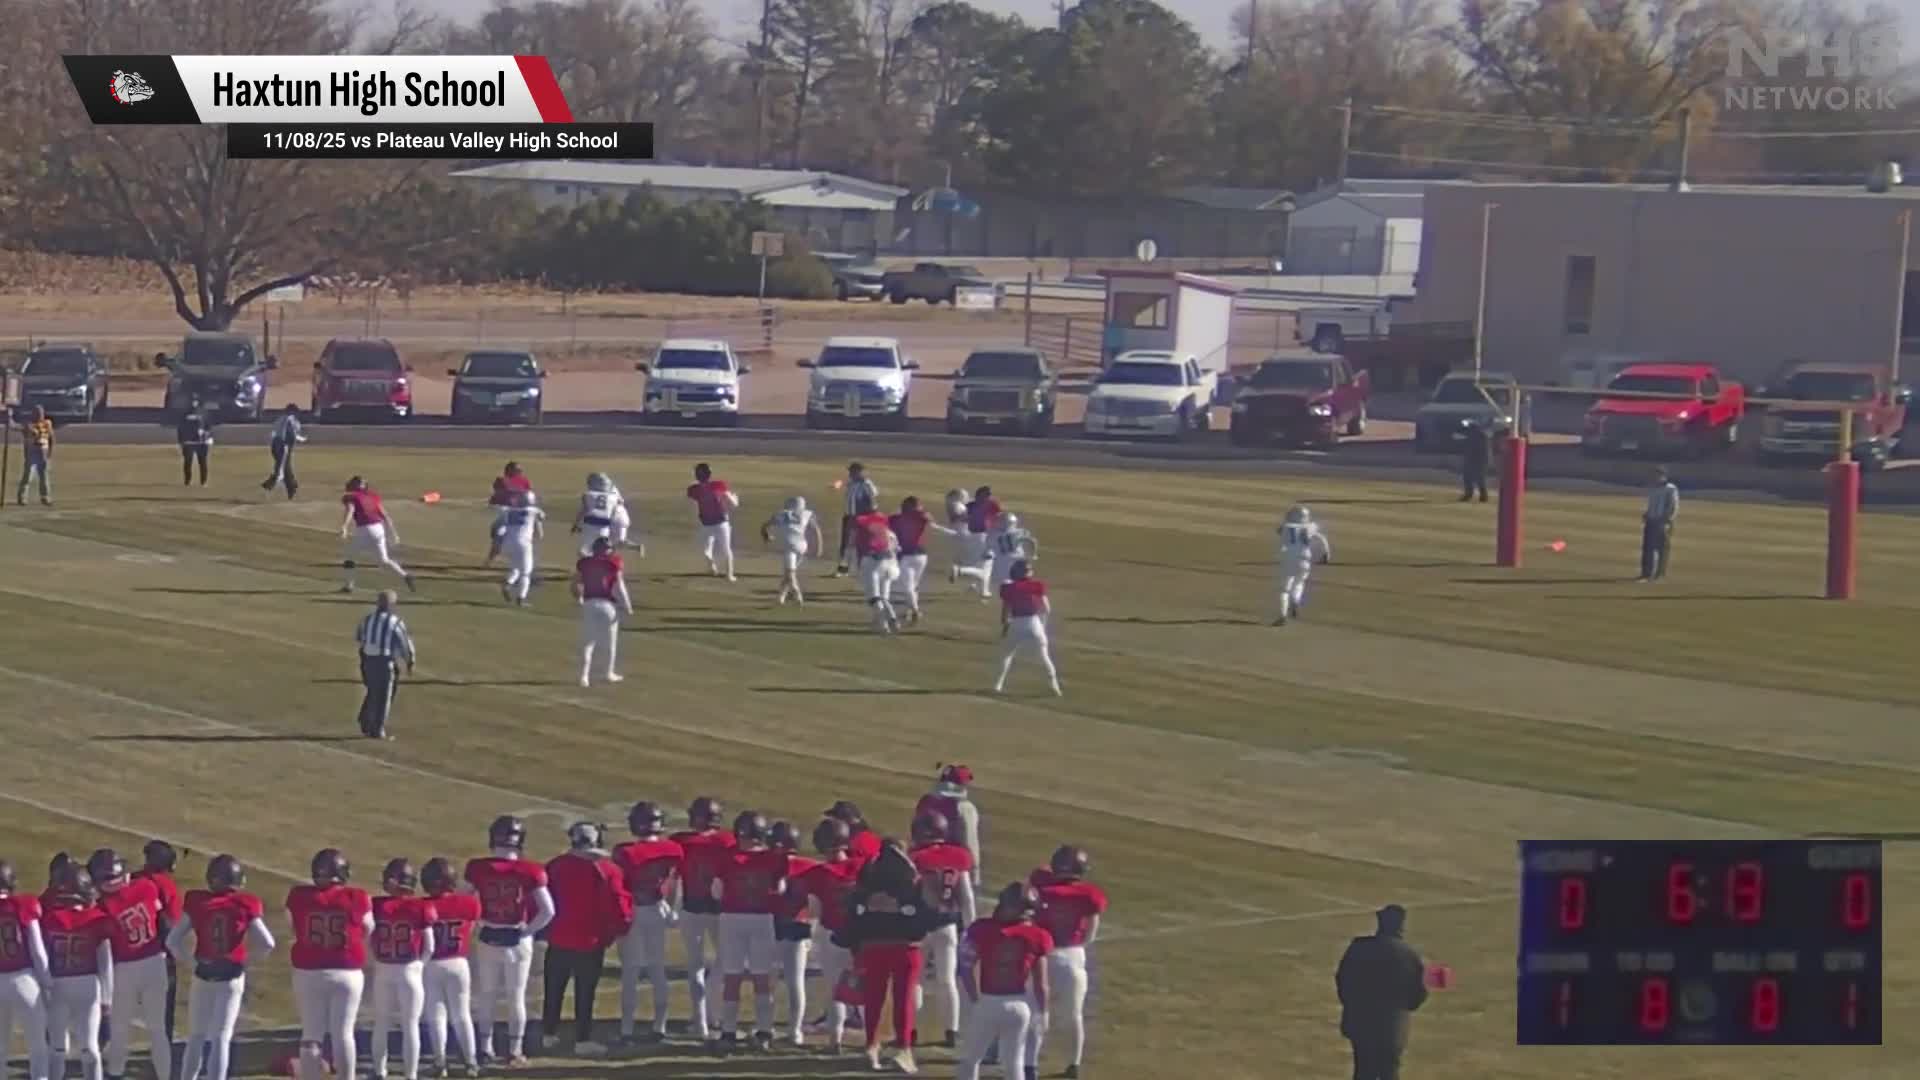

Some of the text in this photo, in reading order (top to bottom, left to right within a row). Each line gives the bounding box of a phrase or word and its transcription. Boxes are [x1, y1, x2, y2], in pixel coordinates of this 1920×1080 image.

[1560, 877, 1585, 929] 0
[1844, 874, 1871, 927] 0
[1559, 981, 1571, 1030] 1
[1847, 982, 1858, 1030] 1
